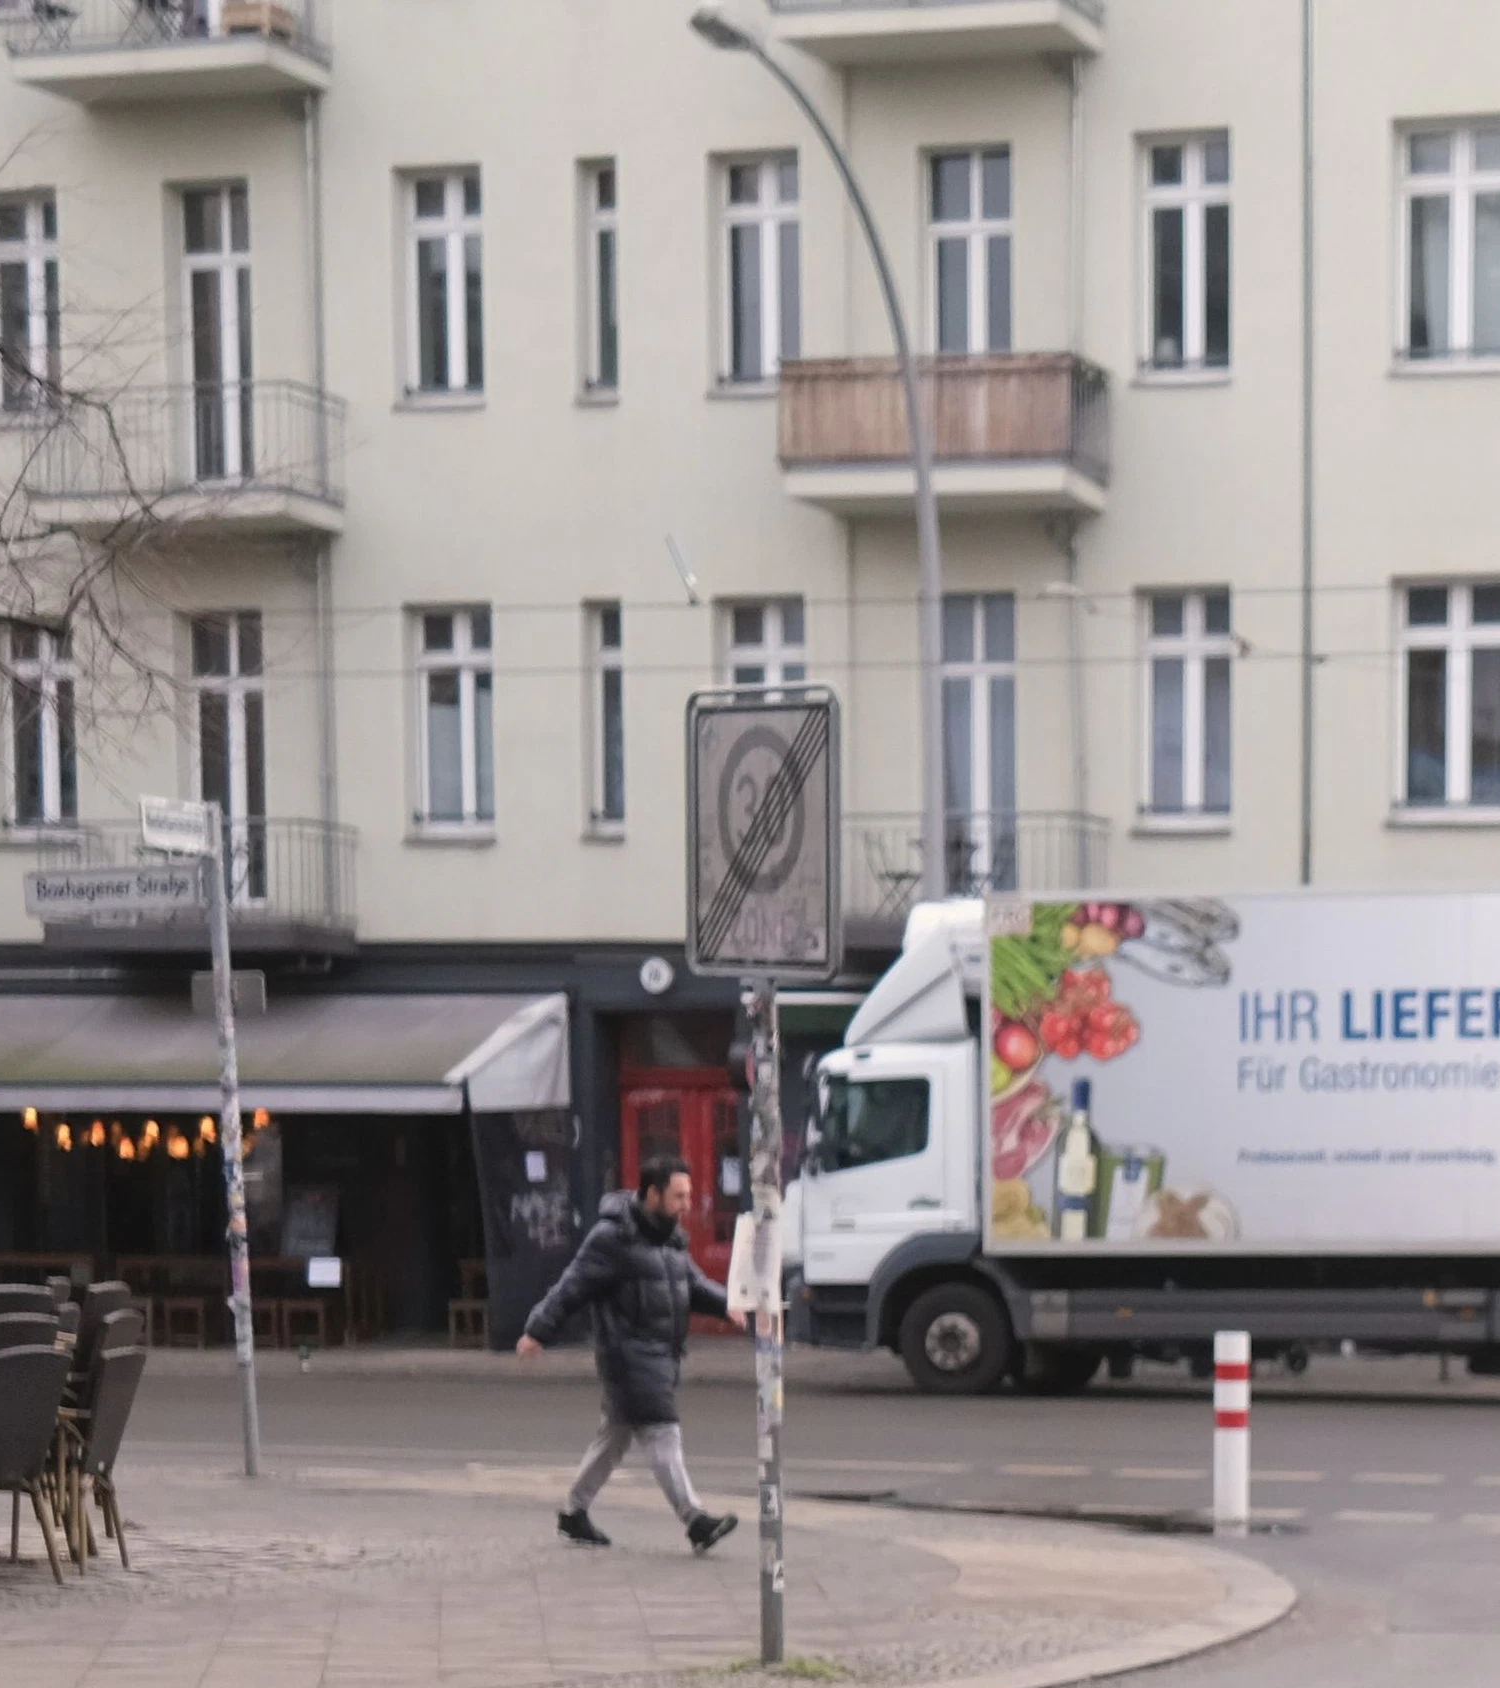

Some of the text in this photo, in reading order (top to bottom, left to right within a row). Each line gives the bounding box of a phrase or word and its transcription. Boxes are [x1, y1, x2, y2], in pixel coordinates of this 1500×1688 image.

[36, 872, 189, 903] Boxhagener Straße
[1239, 988, 1319, 1042] IHR
[1236, 1054, 1287, 1092] Für
